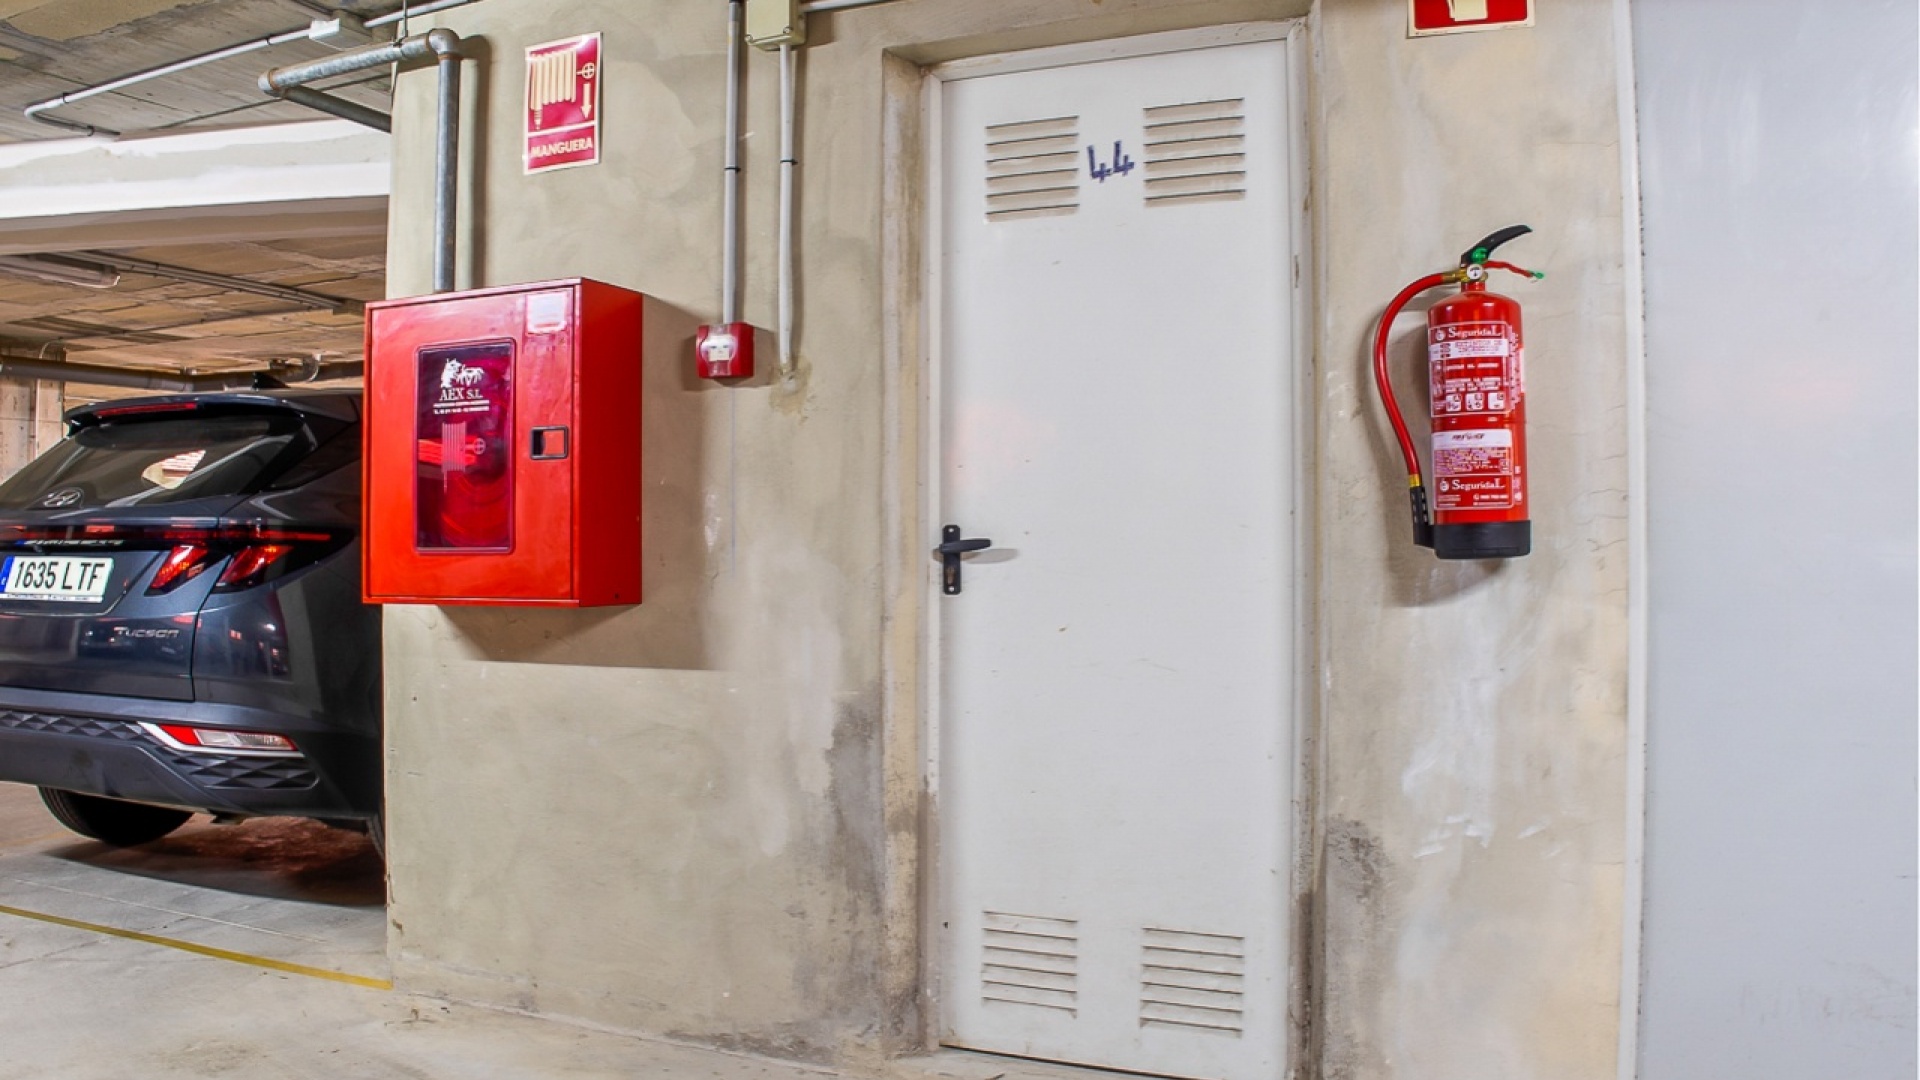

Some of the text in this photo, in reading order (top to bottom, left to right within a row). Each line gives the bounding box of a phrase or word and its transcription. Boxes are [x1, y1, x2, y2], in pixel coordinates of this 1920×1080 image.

[530, 137, 593, 157] MANGUERA
[1087, 140, 1135, 183] 44
[439, 387, 465, 401] AEX
[14, 561, 105, 591] 1635 LTF
